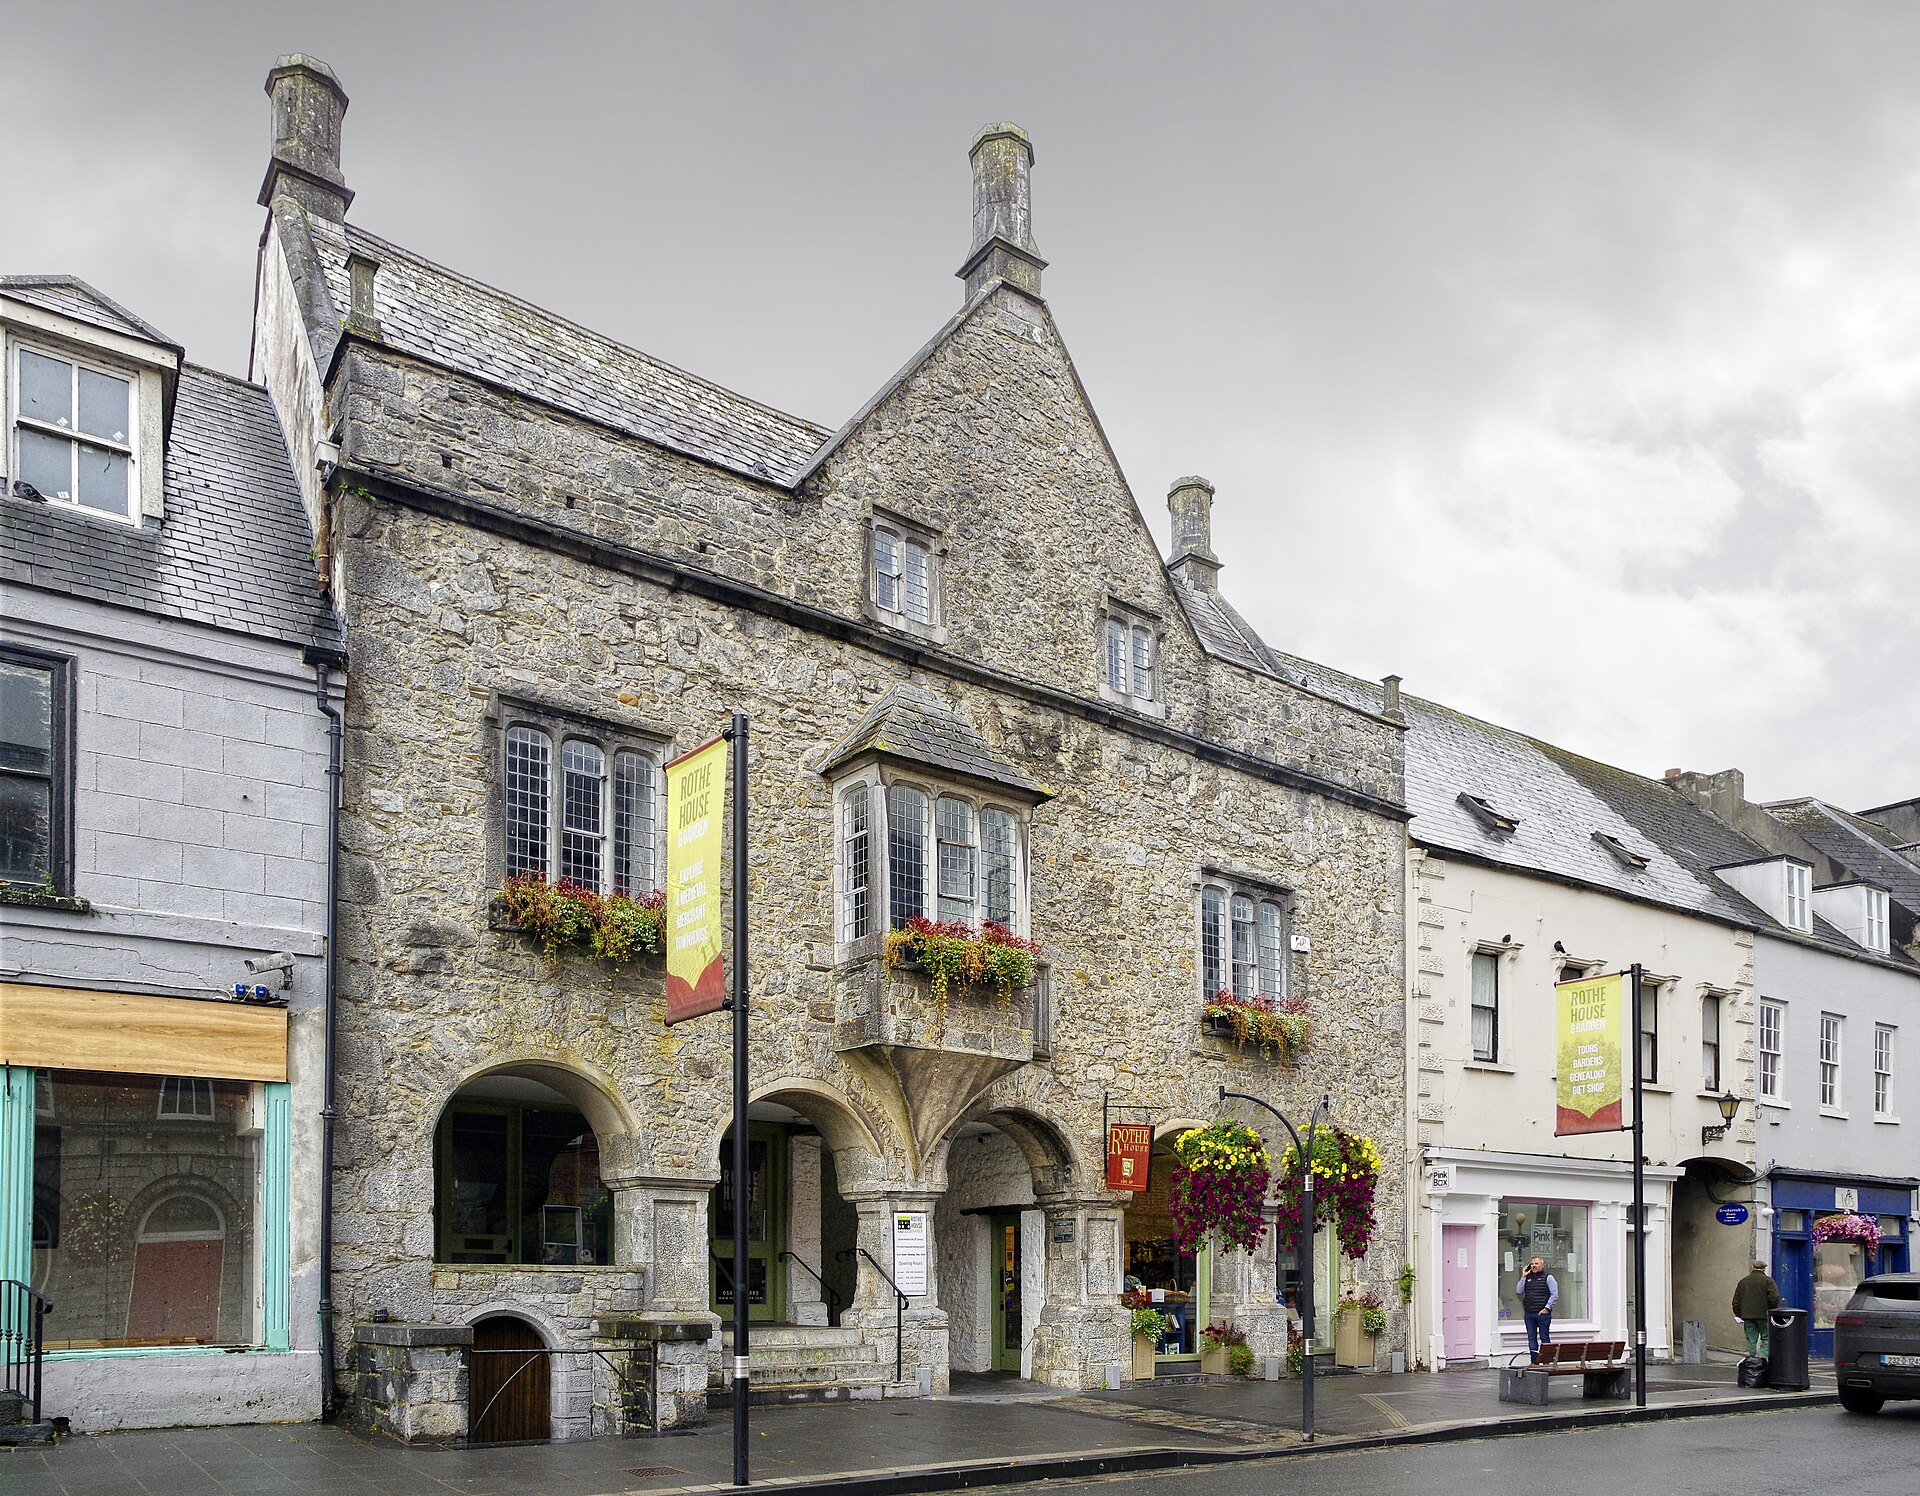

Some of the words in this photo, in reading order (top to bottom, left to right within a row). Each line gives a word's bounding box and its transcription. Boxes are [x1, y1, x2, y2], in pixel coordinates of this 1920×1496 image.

[681, 762, 712, 801] ROTHE
[679, 791, 710, 829] HOUSE
[1571, 986, 1606, 1006] ROTHE
[1570, 1003, 1606, 1023] HOUSE
[1576, 1018, 1606, 1032] GARDEN
[1577, 1043, 1599, 1055] TOURS
[1573, 1056, 1604, 1069] GARDENS
[1569, 1069, 1607, 1082] GENEALOGY
[1572, 1085, 1586, 1095] GIFT
[1586, 1083, 1605, 1093] SHOP
[1109, 1128, 1149, 1155] ROTHE
[1123, 1143, 1149, 1153] HOUSE
[1433, 1170, 1448, 1179] Pink
[1433, 1179, 1448, 1187] Box
[723, 1184, 758, 1200] HSE
[1533, 1230, 1551, 1242] Pink
[1533, 1242, 1551, 1253] Box
[1887, 1356, 1920, 1367] 232-D-124
